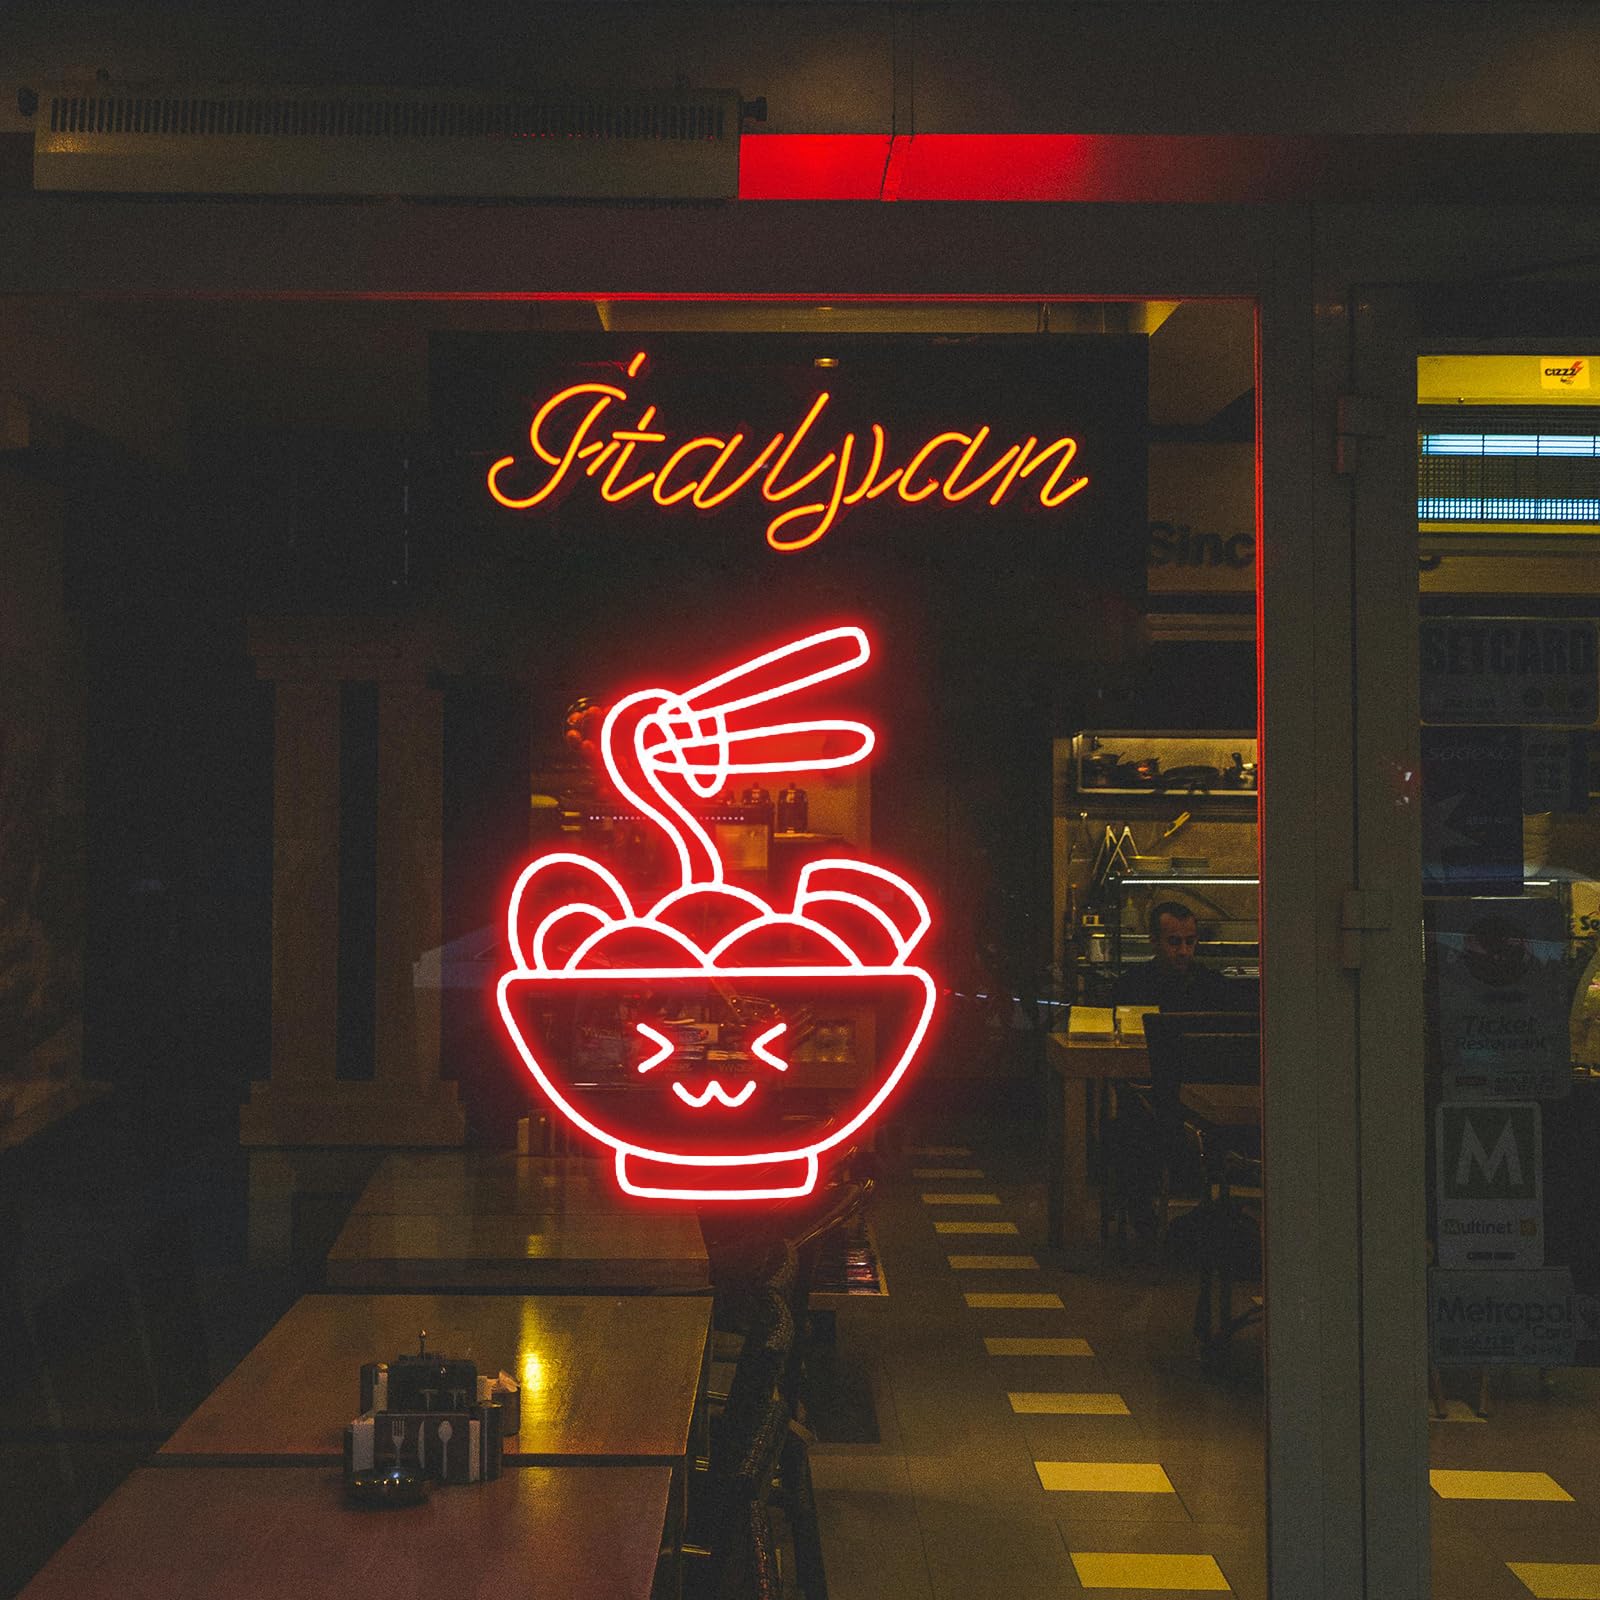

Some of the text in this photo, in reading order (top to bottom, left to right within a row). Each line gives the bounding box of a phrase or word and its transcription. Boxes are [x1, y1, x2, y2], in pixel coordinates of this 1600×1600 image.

[1420, 628, 1594, 674] SETCARD
[1462, 1015, 1538, 1035] Ticket
[1437, 1296, 1572, 1329] Metropol
